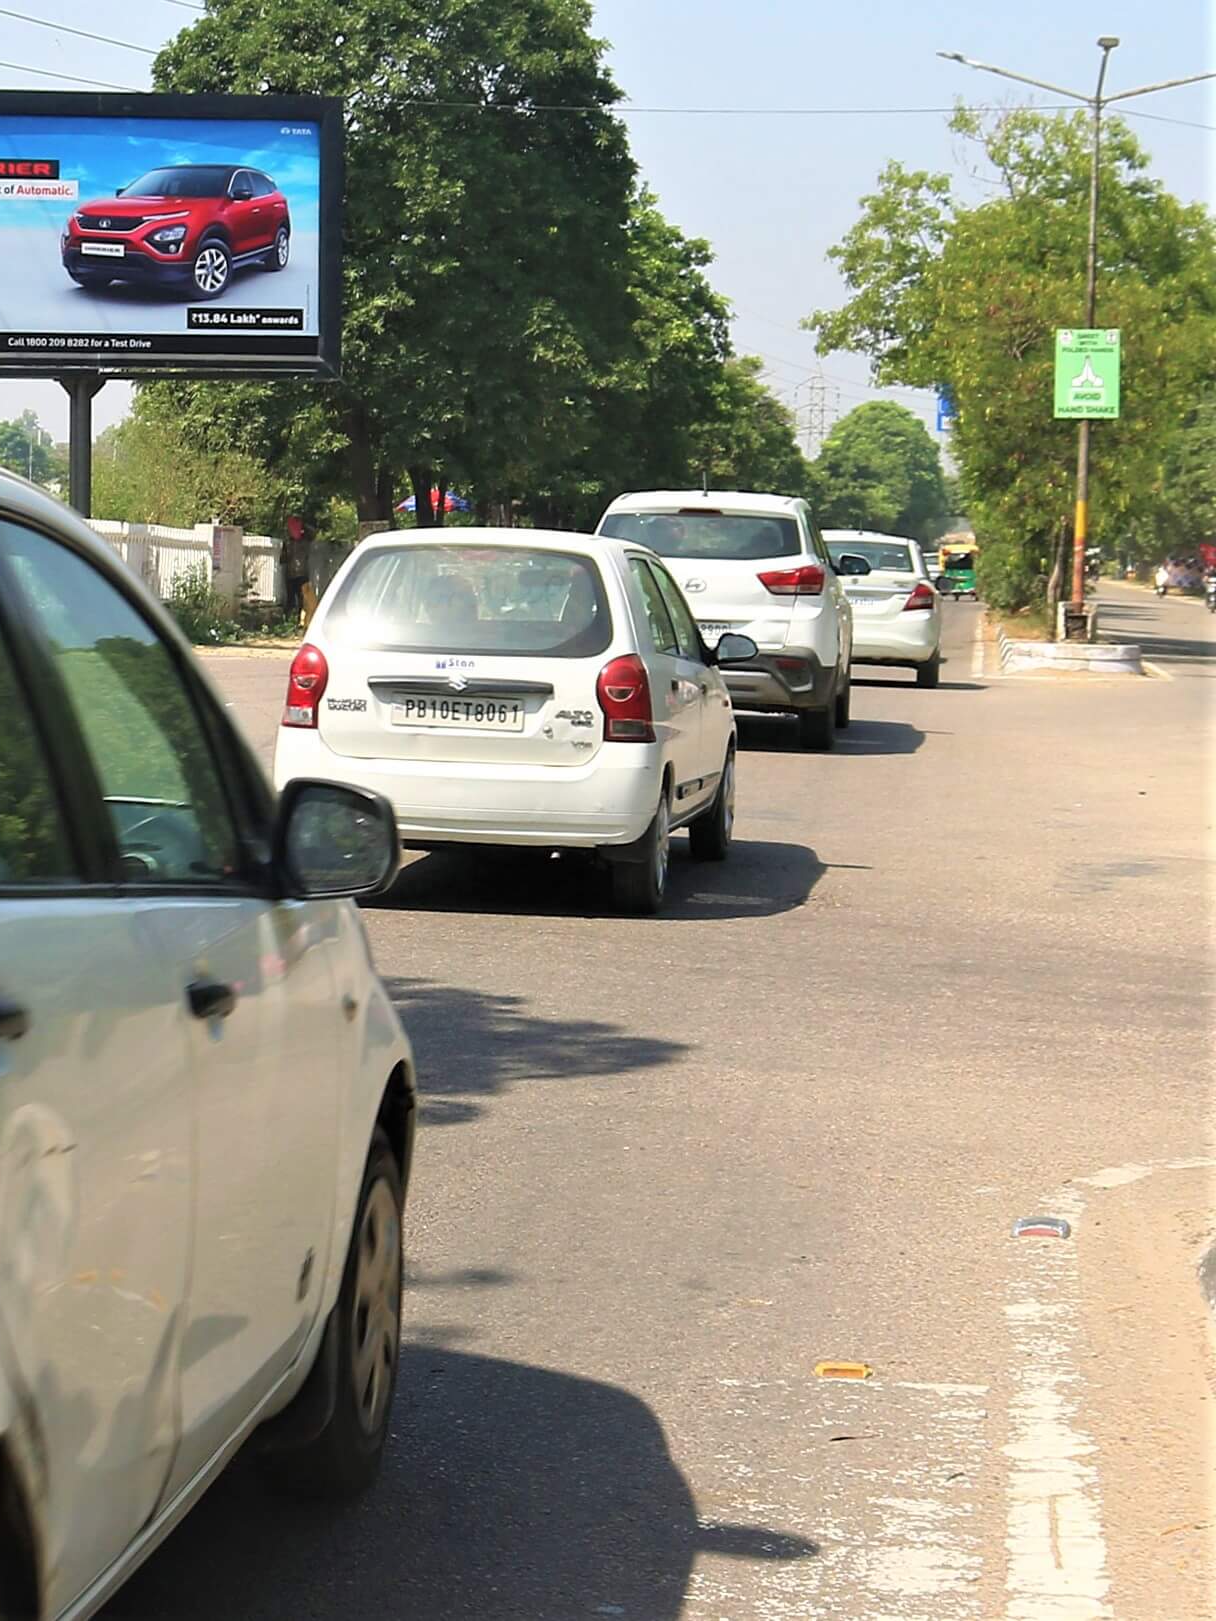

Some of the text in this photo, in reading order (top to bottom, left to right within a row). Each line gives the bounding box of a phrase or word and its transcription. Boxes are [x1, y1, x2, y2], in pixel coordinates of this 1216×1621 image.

[292, 128, 312, 136] TATA
[4, 184, 15, 195] of
[16, 184, 73, 196] Automatic.
[261, 316, 299, 324] onwards
[8, 337, 25, 347] Call
[26, 337, 47, 347] 1800
[48, 337, 65, 347] 209
[67, 338, 89, 347] 8282
[90, 338, 103, 347] for
[111, 338, 128, 348] Test
[129, 339, 151, 348] Drive
[405, 699, 519, 724] PB10ET8061
